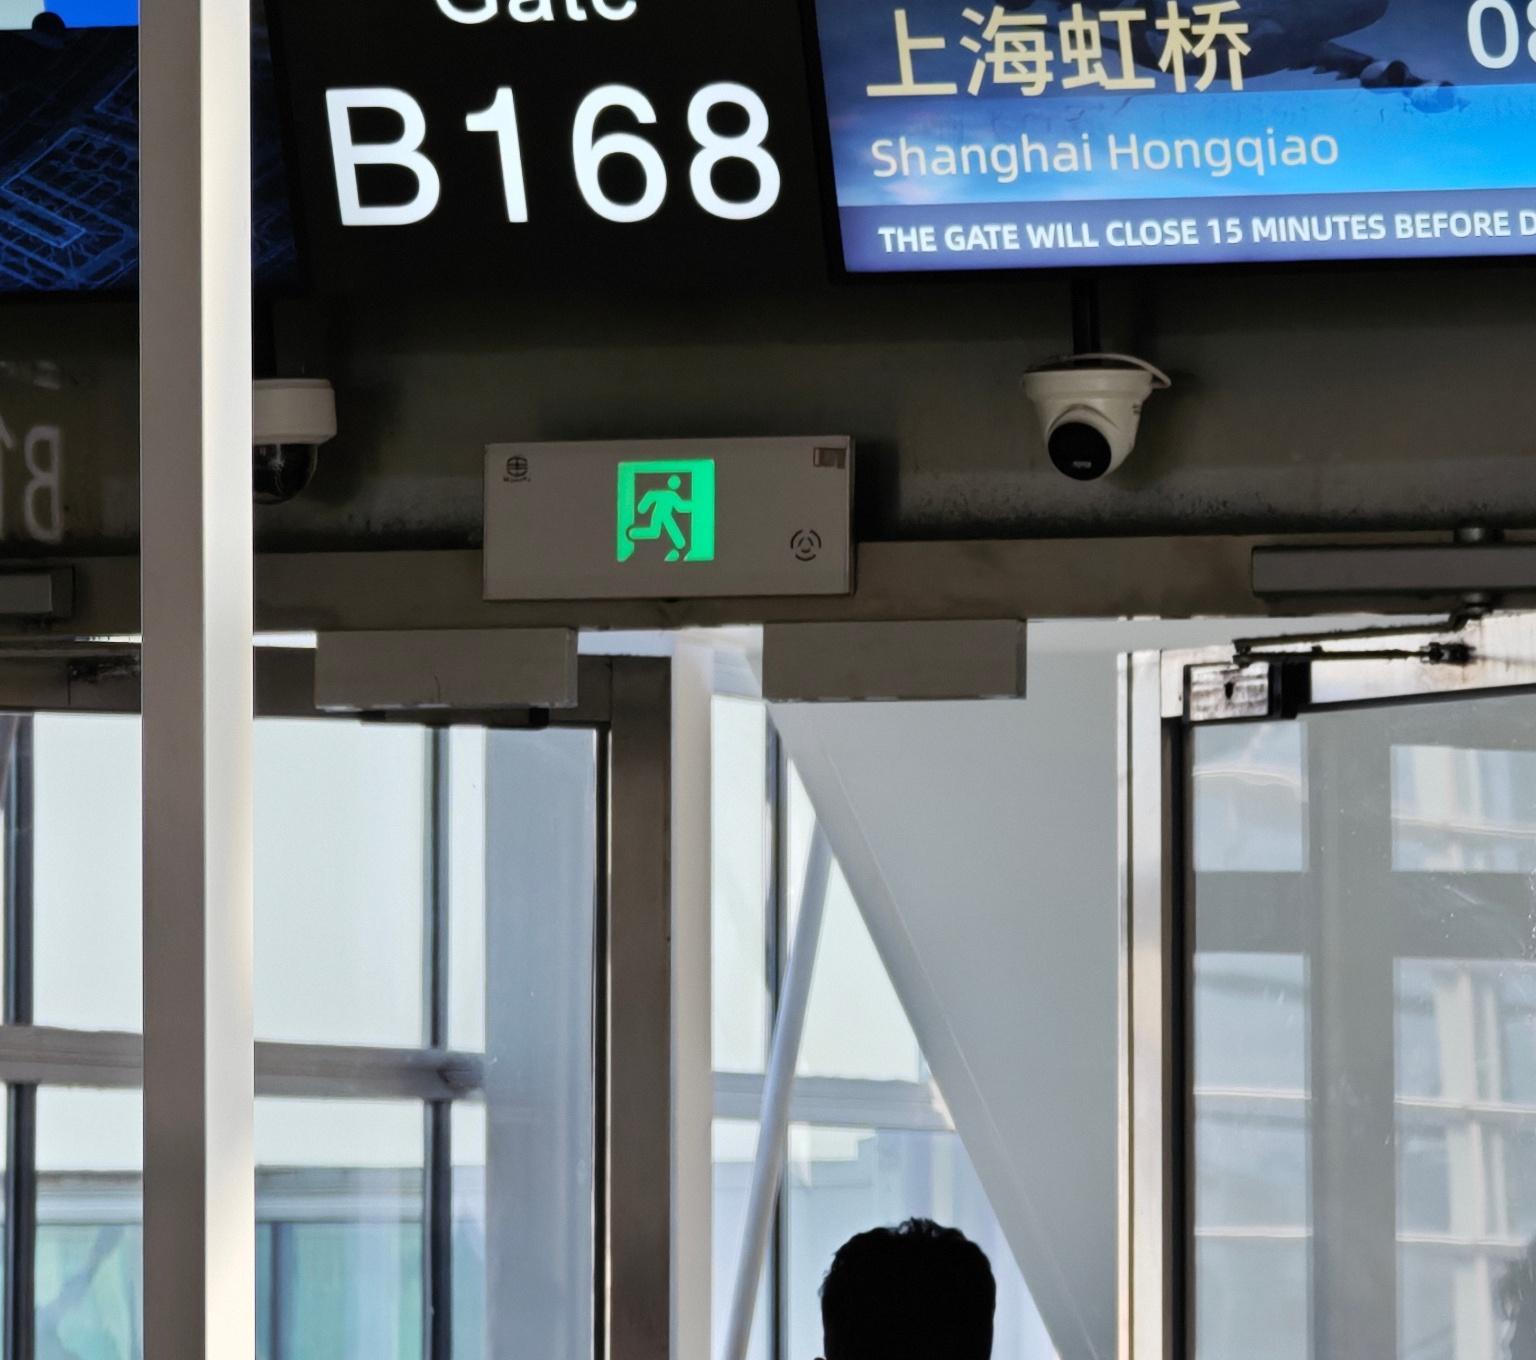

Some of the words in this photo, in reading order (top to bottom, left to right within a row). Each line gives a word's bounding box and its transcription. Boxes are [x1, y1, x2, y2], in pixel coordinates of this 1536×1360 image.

[866, 0, 1251, 97] 上海虹桥
[326, 82, 780, 226] B168
[871, 133, 1093, 183] Shanghai
[1109, 127, 1339, 178] Hongqiao
[878, 226, 937, 253] THE
[944, 224, 1020, 252] GATE
[1027, 222, 1101, 249] WILL
[1106, 219, 1199, 247] CLOSE
[1207, 218, 1242, 244] 15
[1252, 214, 1386, 242] MINUTES
[1395, 211, 1511, 239] BEFORE
